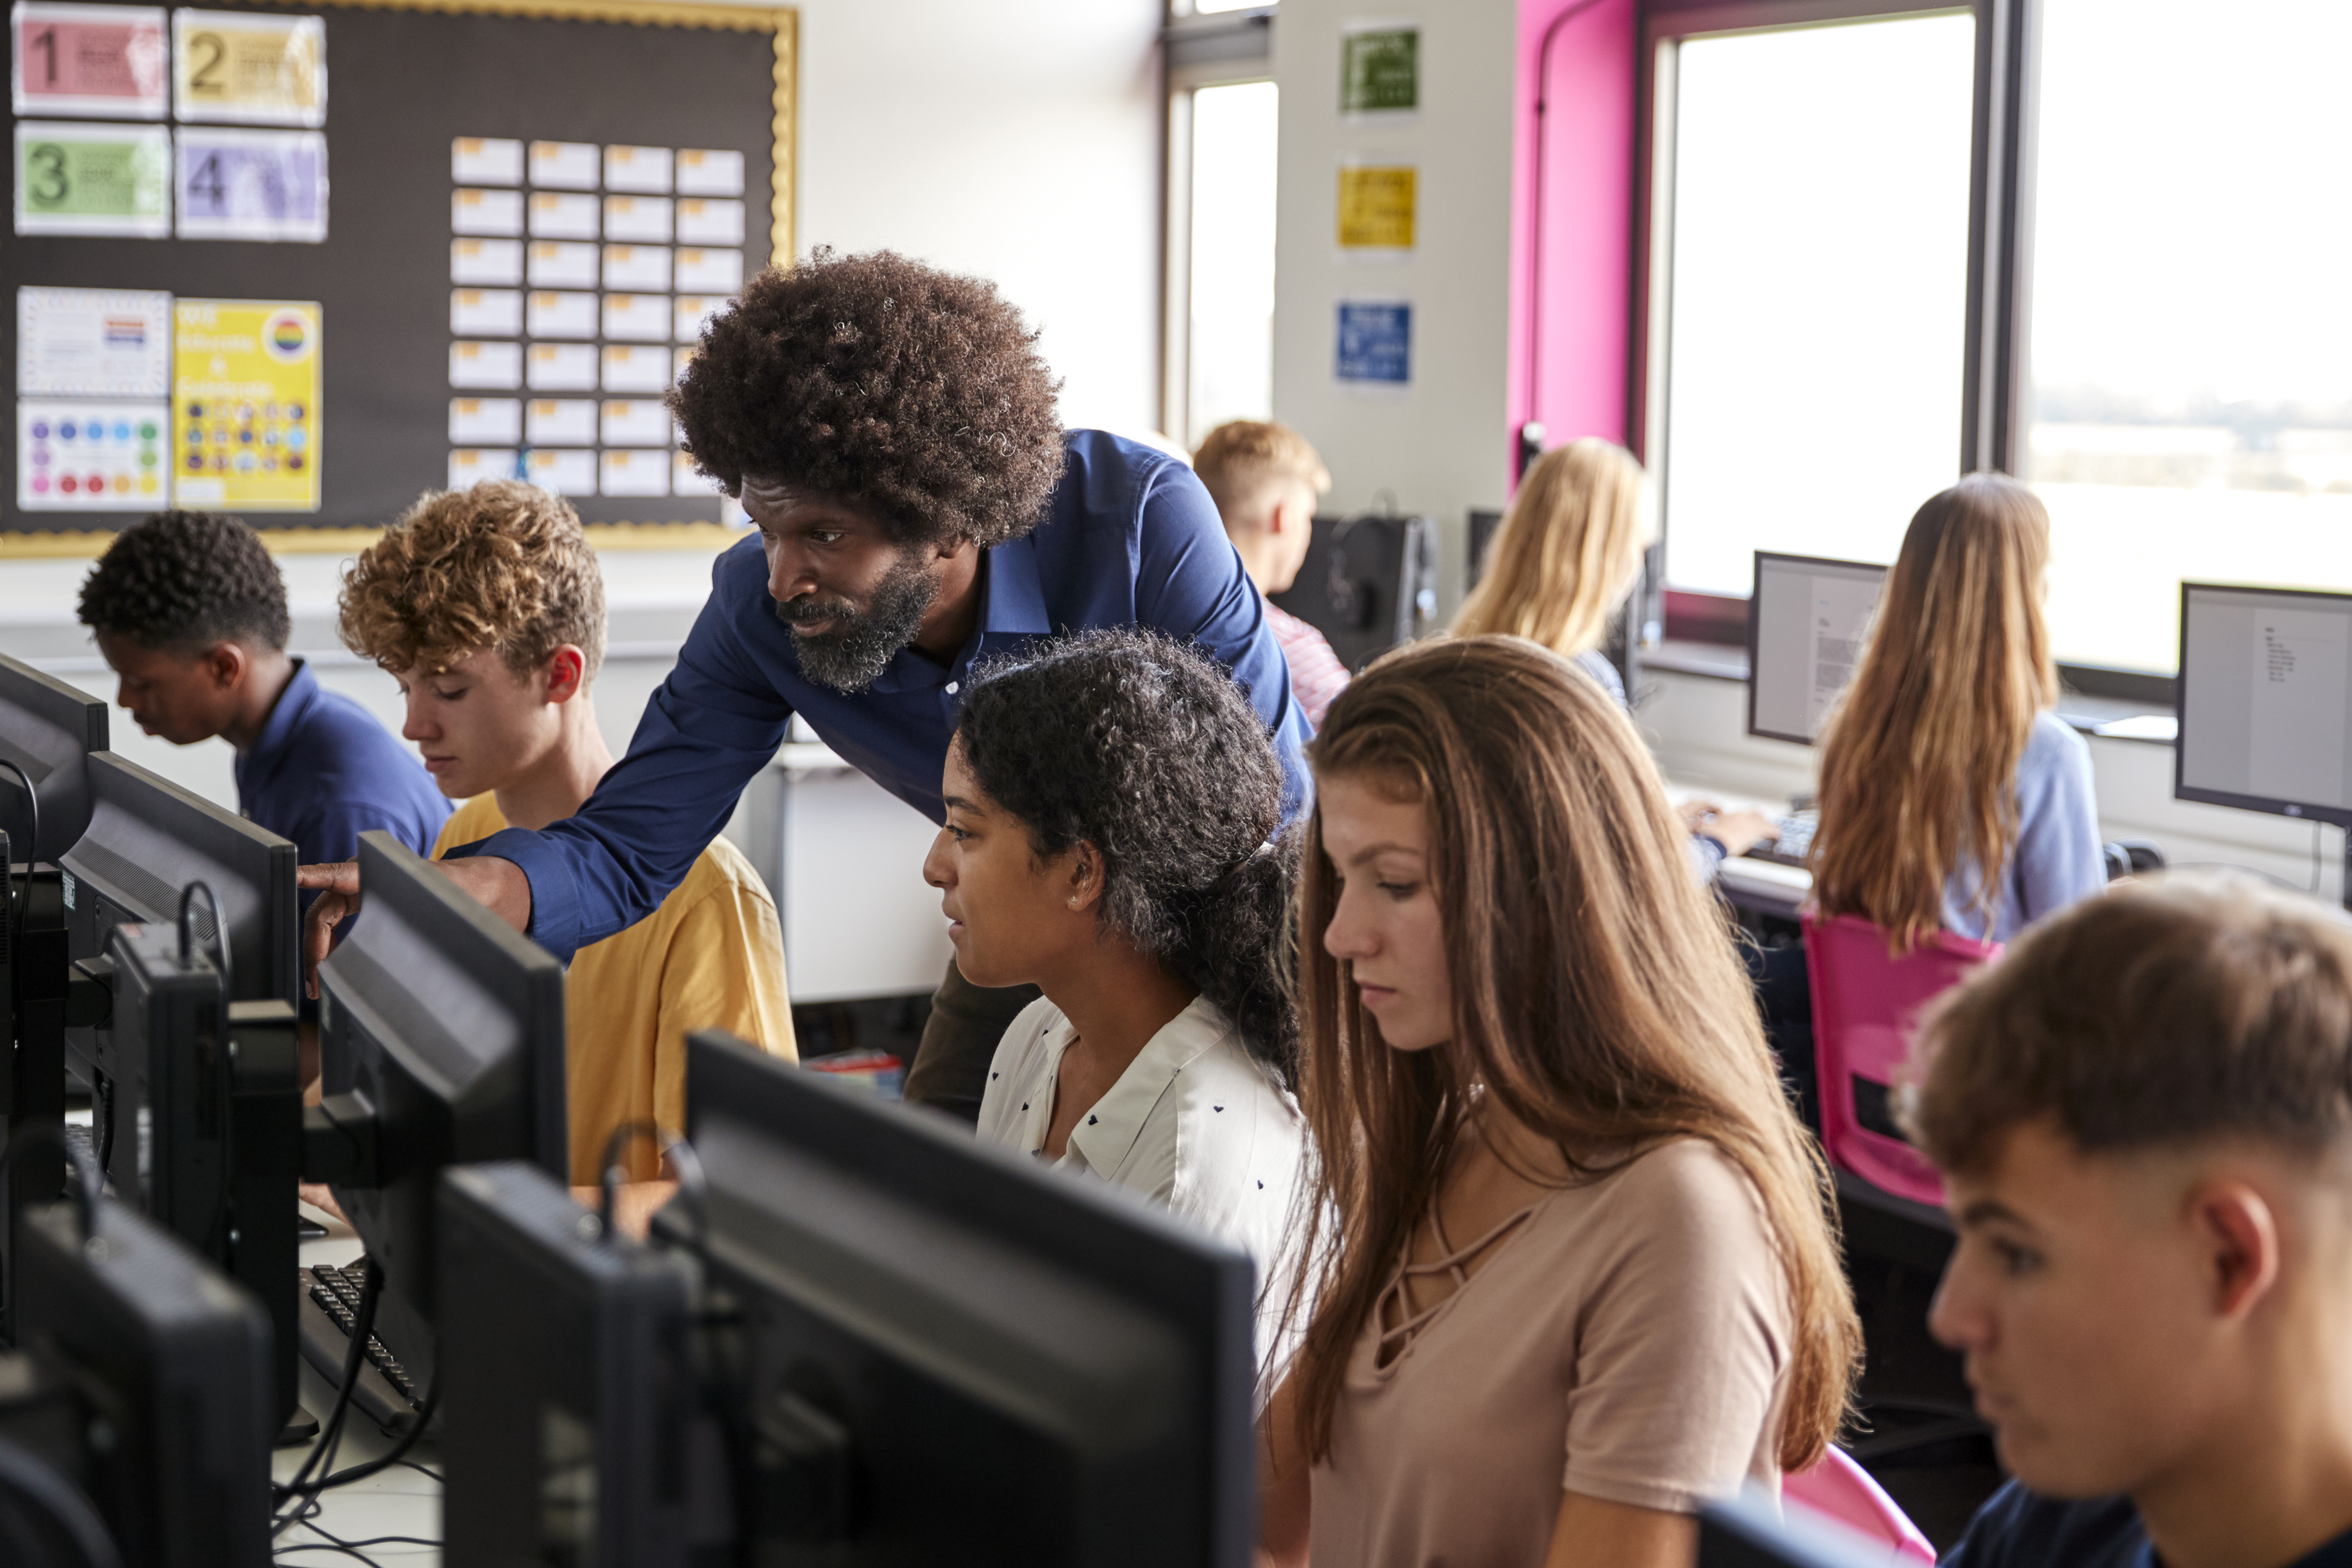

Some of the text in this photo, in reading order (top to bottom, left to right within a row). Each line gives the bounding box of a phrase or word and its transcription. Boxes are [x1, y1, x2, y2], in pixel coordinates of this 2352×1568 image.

[33, 26, 57, 84] 1
[190, 32, 226, 95] 2
[32, 143, 68, 207] 3
[190, 151, 224, 207] 4
